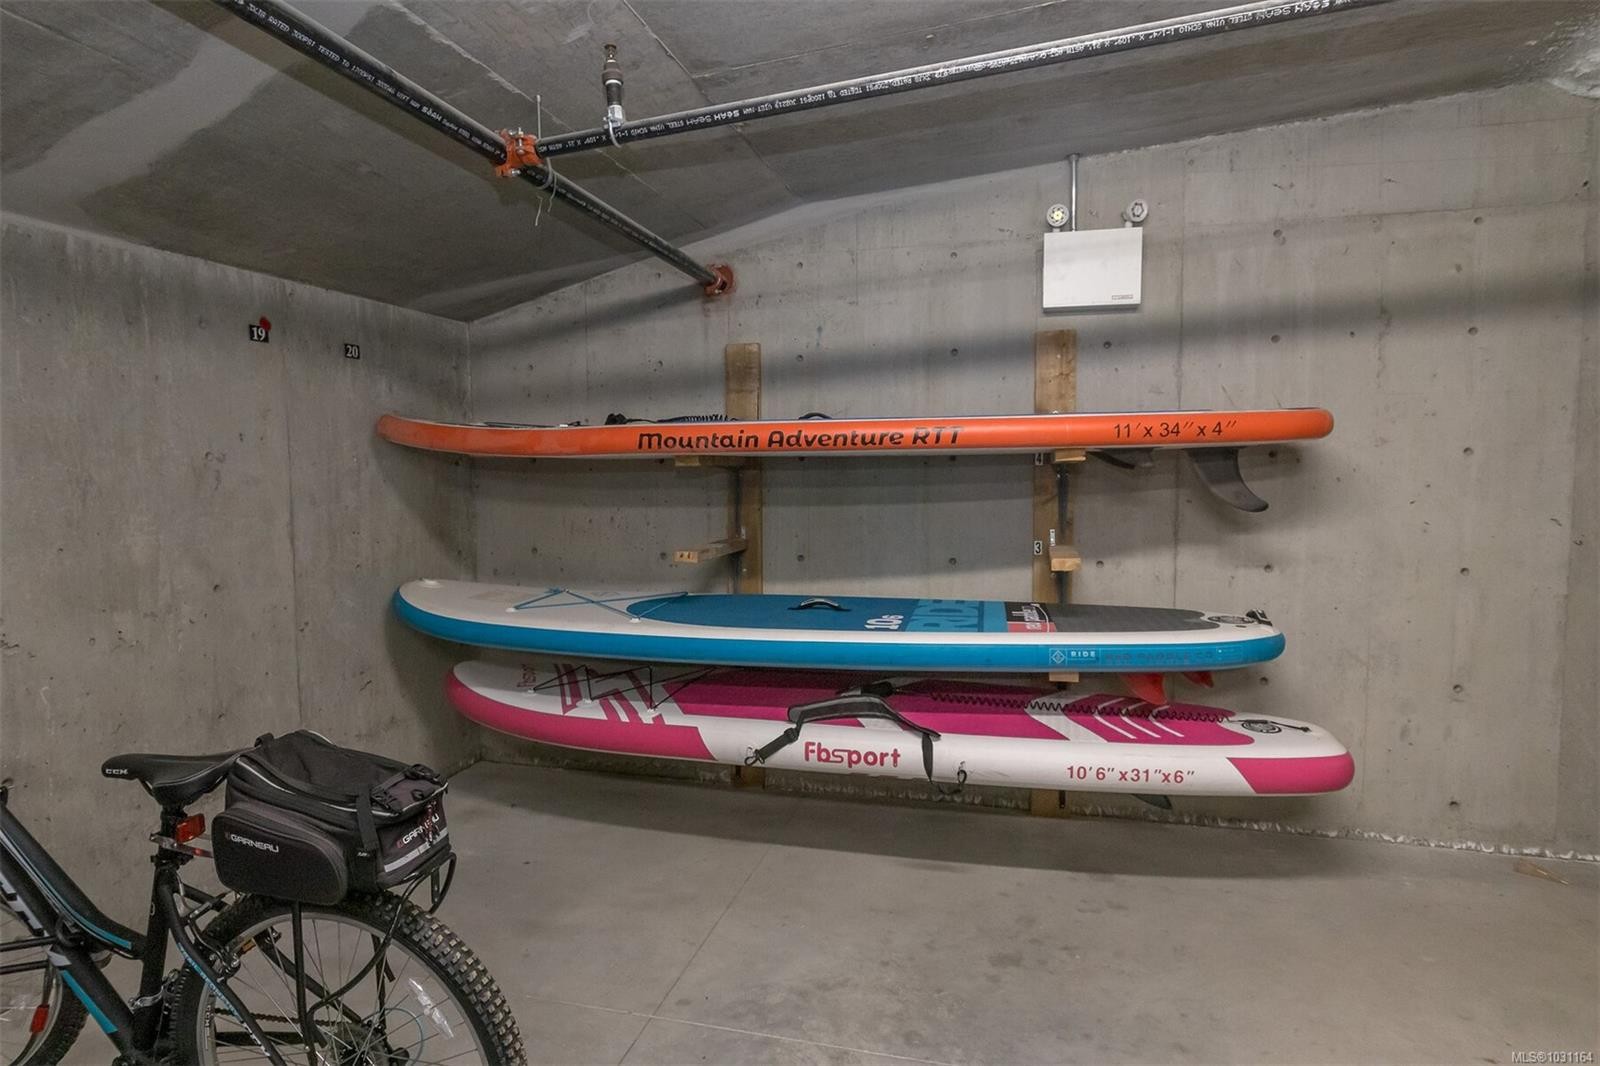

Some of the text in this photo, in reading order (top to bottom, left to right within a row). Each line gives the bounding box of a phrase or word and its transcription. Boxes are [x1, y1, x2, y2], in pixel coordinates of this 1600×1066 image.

[252, 327, 265, 340] 19
[346, 345, 359, 358] 20
[638, 426, 963, 450] Mountain Adventure RTT
[1036, 542, 1041, 553] 3
[804, 741, 901, 768] Fbsport
[231, 834, 279, 853] GARNEAU
